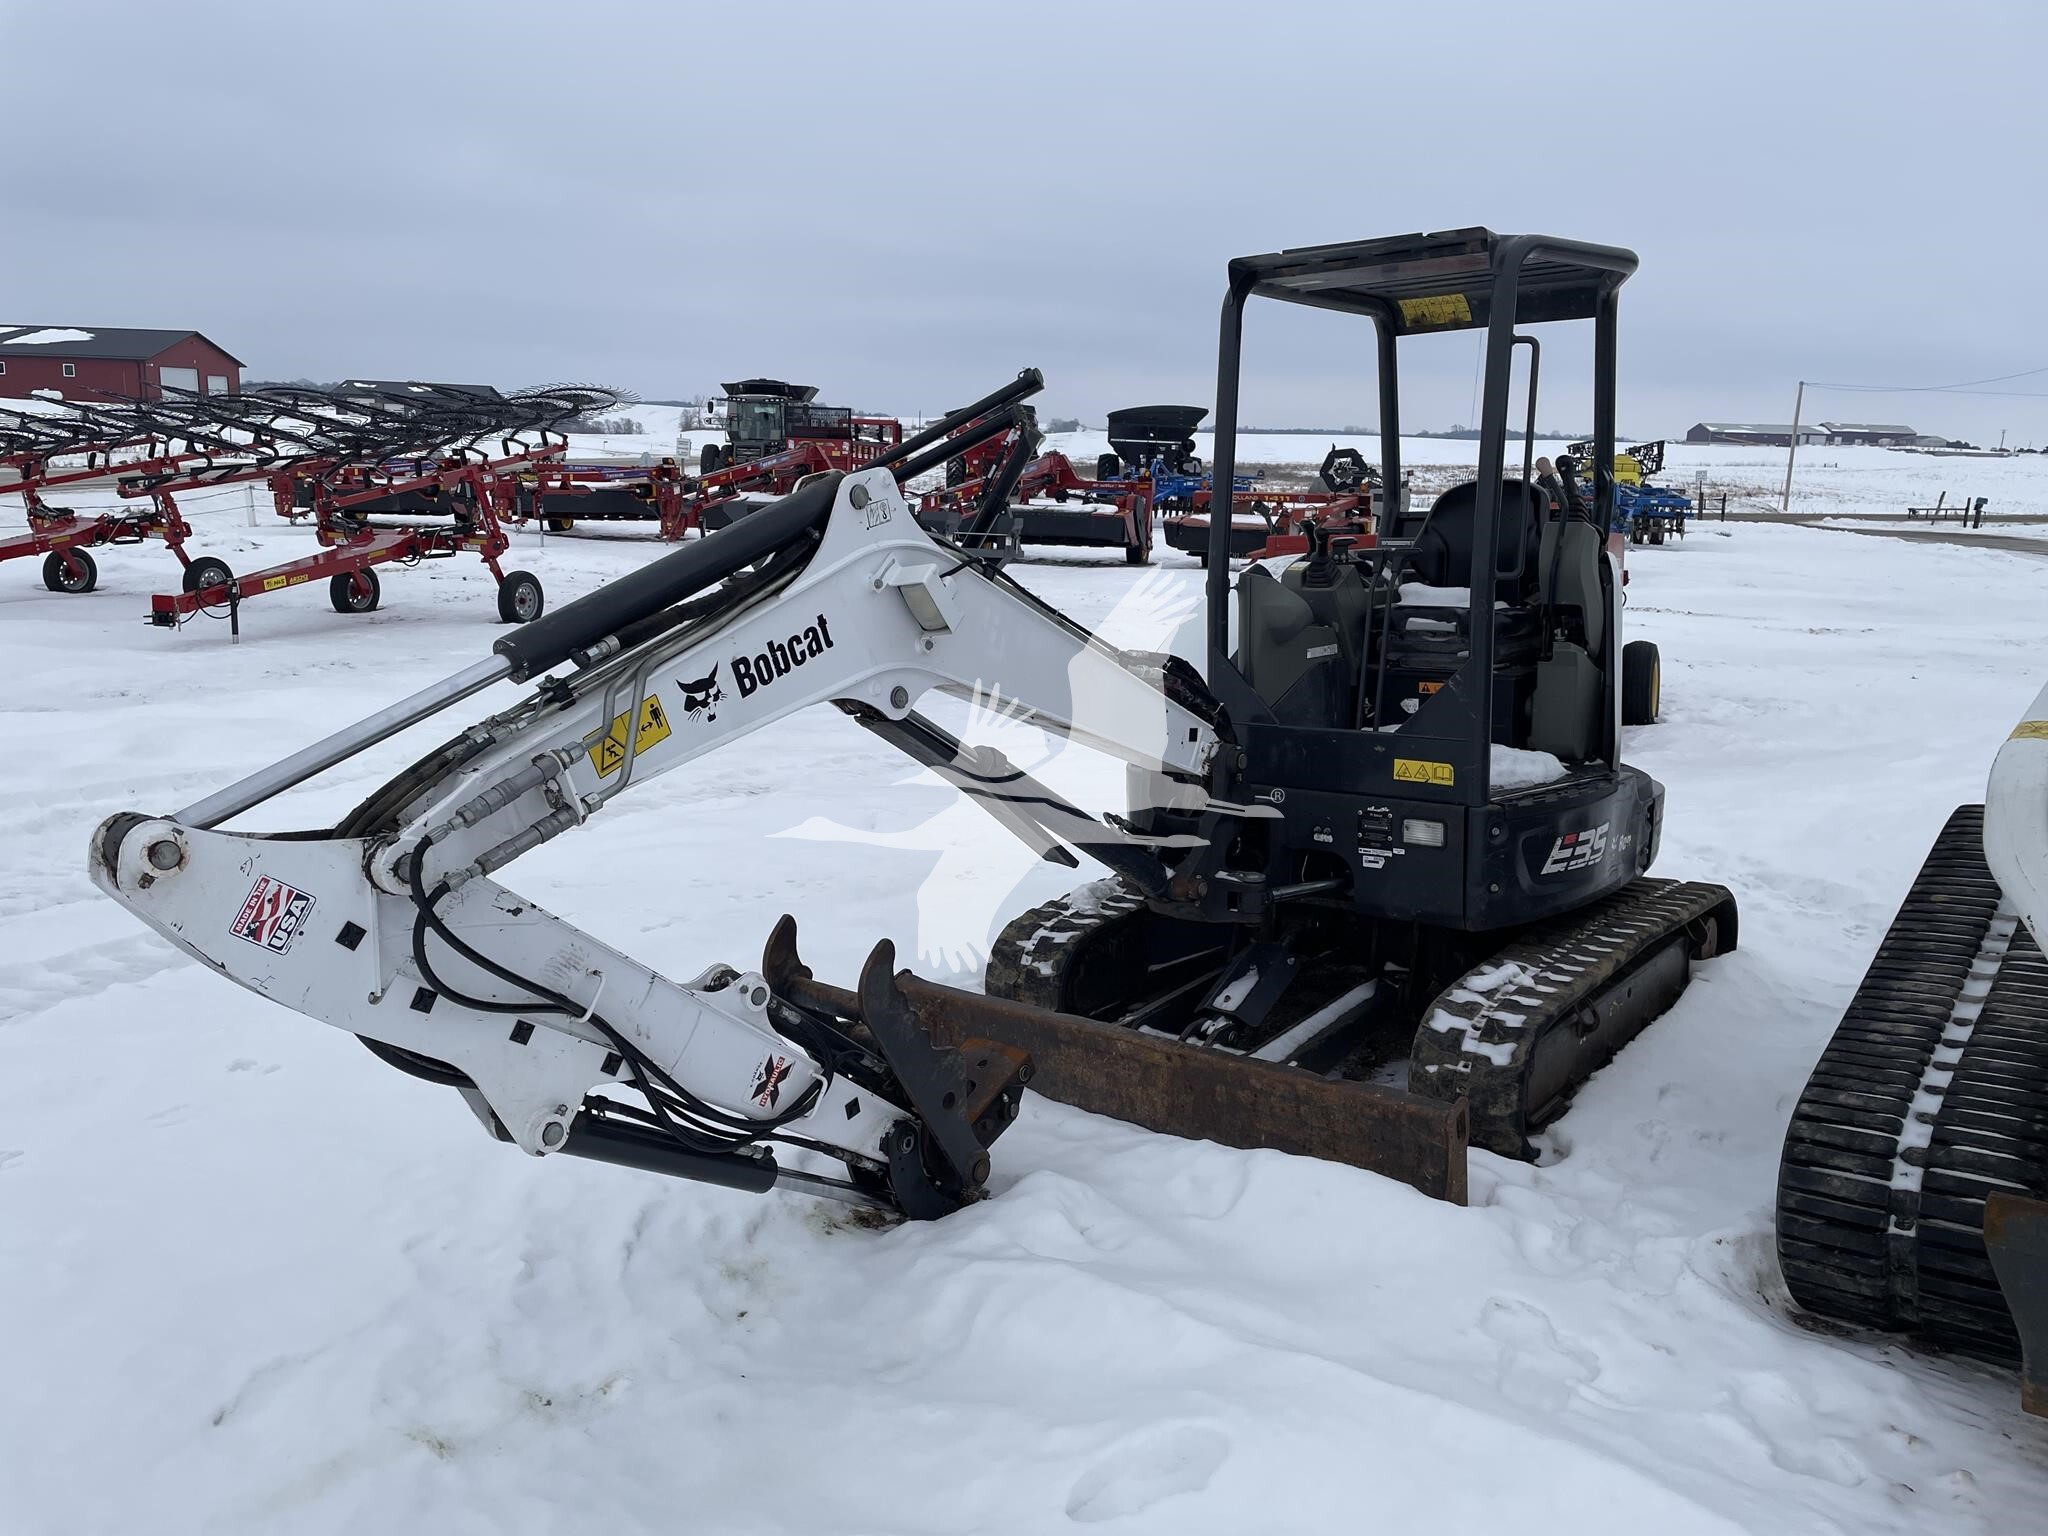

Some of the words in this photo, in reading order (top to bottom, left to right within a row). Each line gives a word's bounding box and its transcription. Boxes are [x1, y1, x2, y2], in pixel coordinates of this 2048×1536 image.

[731, 613, 834, 699] Bobcat
[1541, 822, 1610, 875] E35
[235, 907, 253, 932] MADE
[249, 896, 258, 908] IN
[254, 881, 268, 897] THE
[270, 900, 308, 948] USA
[759, 1057, 784, 1106] HYDRAULIC
